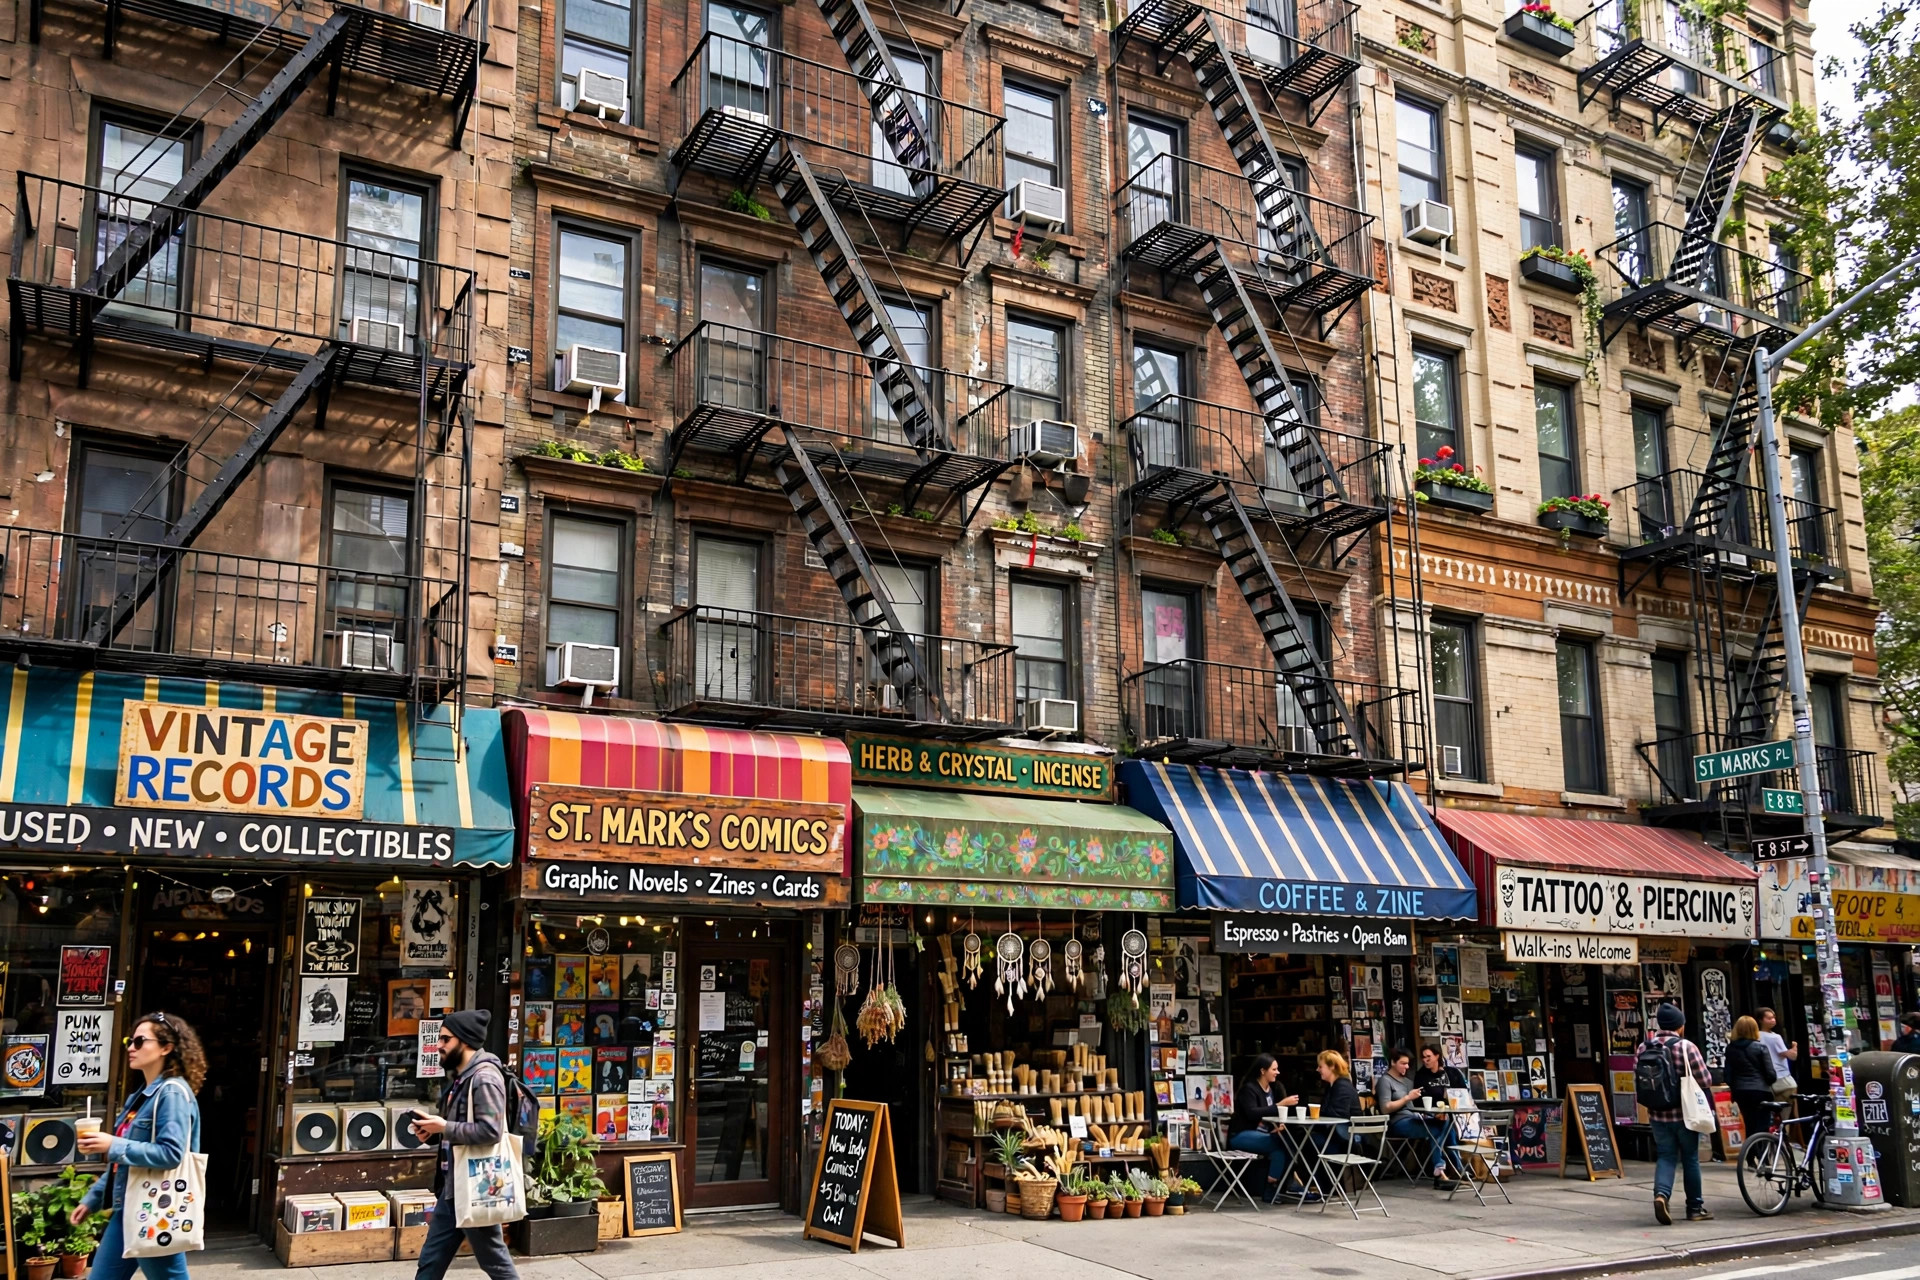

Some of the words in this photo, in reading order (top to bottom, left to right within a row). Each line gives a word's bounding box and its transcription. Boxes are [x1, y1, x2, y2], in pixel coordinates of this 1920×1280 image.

[139, 707, 355, 765] VINTAGE
[860, 743, 914, 772] HERB
[919, 752, 932, 772] &
[938, 752, 1018, 781] CRYSTAL
[1033, 760, 1102, 789] INCENSE
[1699, 759, 1714, 776] ST
[1721, 749, 1770, 774] MARKS
[1776, 748, 1790, 761] PL
[127, 755, 352, 811] RECORDS
[1767, 793, 1774, 808] E
[1777, 794, 1784, 808] 8
[1786, 795, 1795, 808] ST
[0, 809, 91, 844] USED
[129, 817, 205, 850] NEW
[239, 823, 452, 862] COLLECTIBLES
[547, 802, 592, 842] ST.
[601, 805, 710, 849] MARK'S
[720, 815, 828, 855] COMICS
[1758, 843, 1765, 857] E
[1769, 842, 1777, 857] 8
[1780, 840, 1791, 853] ST
[545, 864, 619, 896] Graphic
[629, 868, 688, 893] Novels
[708, 872, 755, 896] Zines
[772, 875, 820, 898] Cards
[1259, 882, 1345, 912] COFFEE
[1355, 890, 1368, 911] &
[1376, 889, 1425, 916] ZINE
[1517, 877, 1603, 916] TATTOO
[1615, 882, 1633, 918] &
[1643, 885, 1737, 924] PIERCING
[1224, 920, 1280, 948] Espresso
[1292, 922, 1340, 944] Pastries
[1352, 929, 1381, 951] Open
[1383, 926, 1408, 947] 8am
[1513, 935, 1573, 960] Walk-ins
[1576, 937, 1632, 962] Welcome
[65, 1014, 101, 1030] PUNK
[69, 1030, 100, 1042] SHOW
[58, 1062, 73, 1078] @
[835, 1112, 869, 1134] TODAY:
[848, 1136, 867, 1160] Indy
[825, 1155, 860, 1179] Comics!
